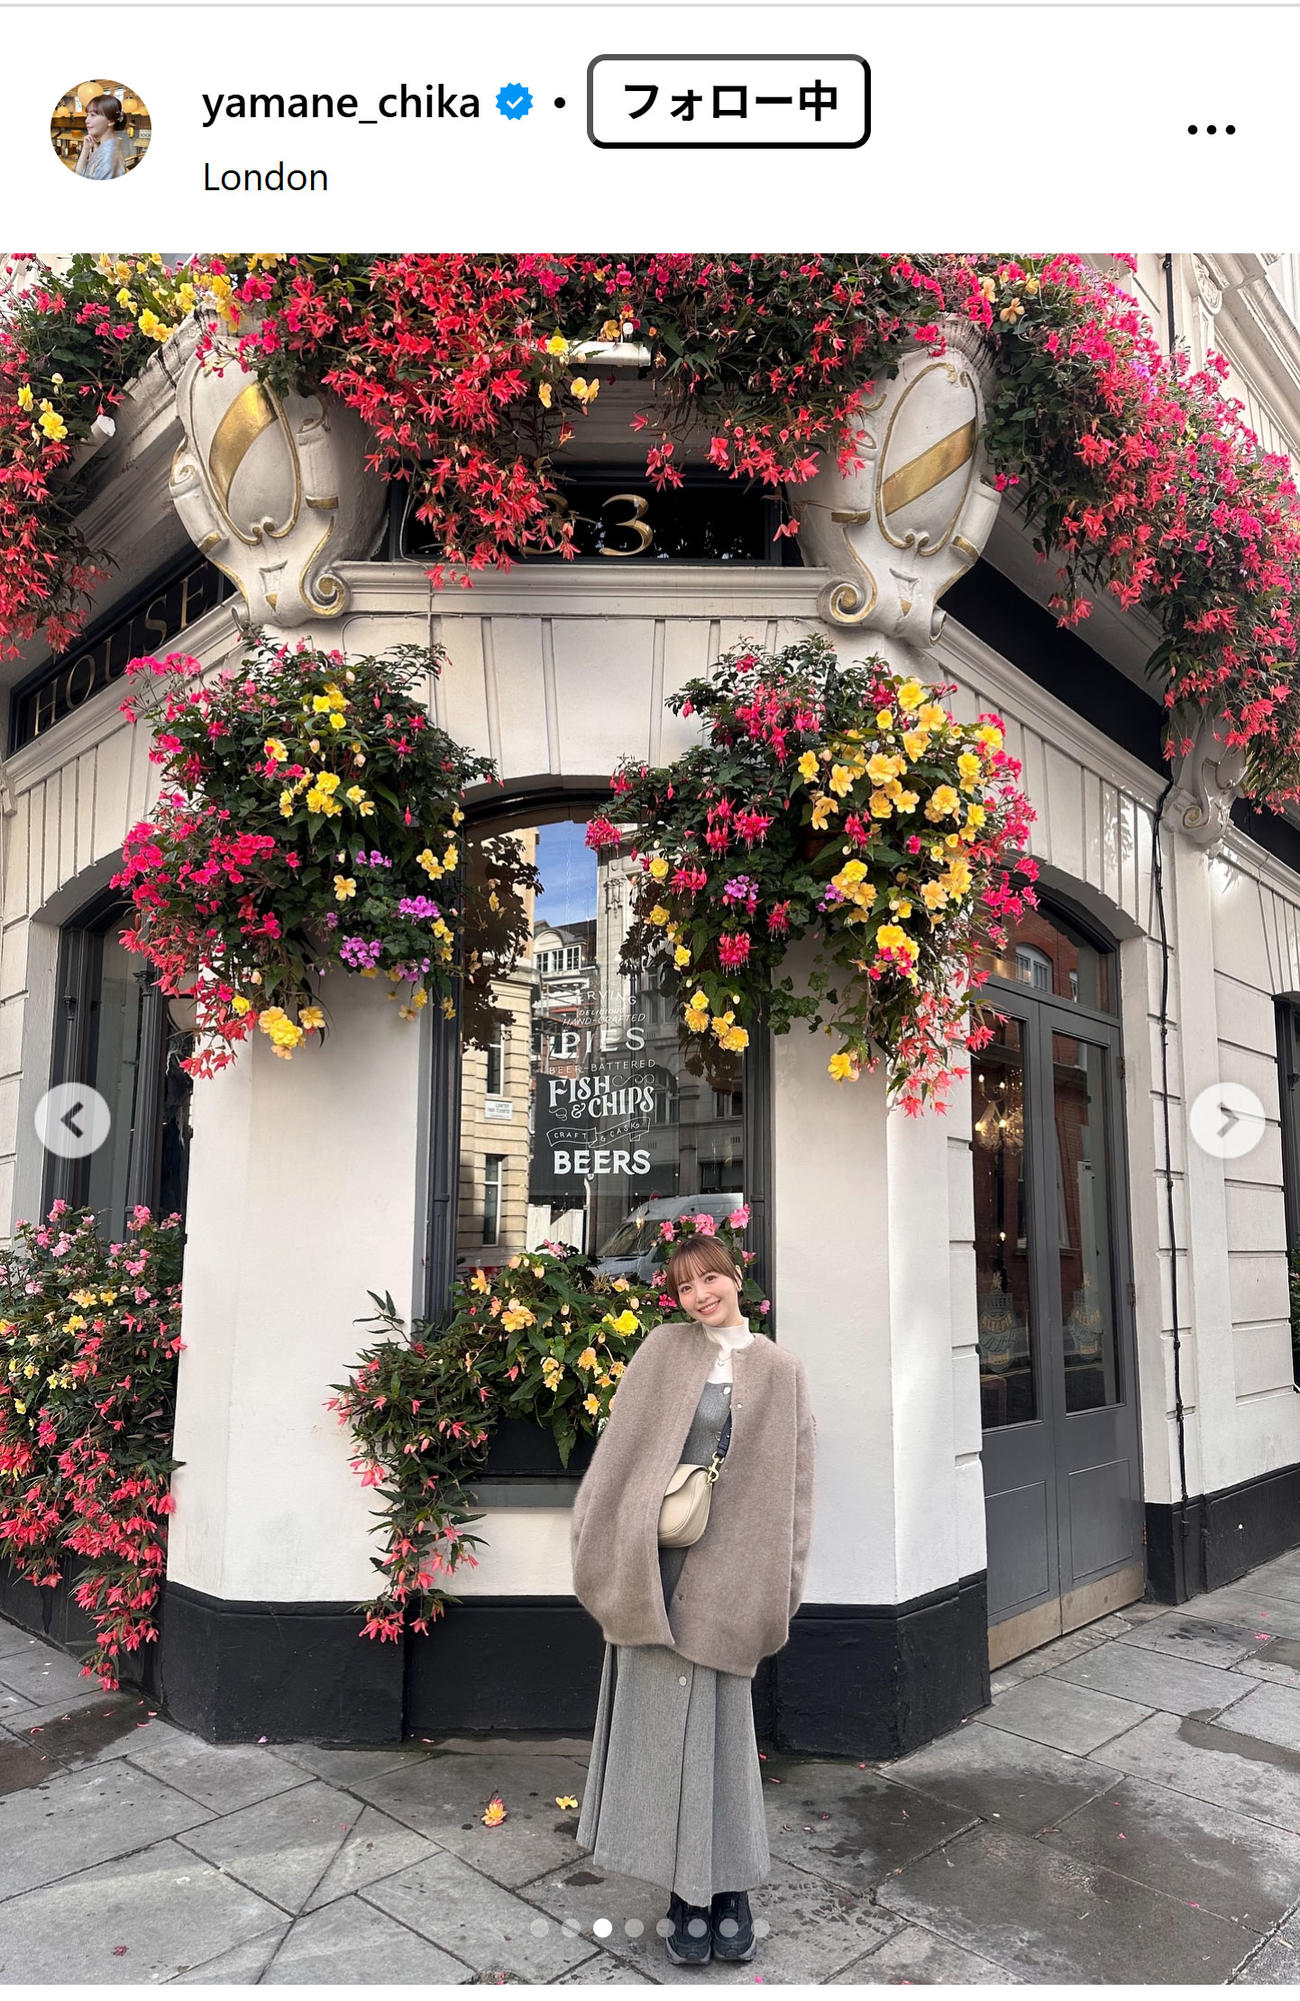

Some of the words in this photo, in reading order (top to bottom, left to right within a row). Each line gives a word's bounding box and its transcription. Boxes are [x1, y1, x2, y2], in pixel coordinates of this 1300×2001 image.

[33, 560, 208, 738] HOUSE
[562, 1013, 646, 1026] HAND-CRAFTED
[561, 1027, 645, 1054] PIES
[549, 1059, 656, 1075] BEER-BATTERED
[548, 1075, 611, 1107] FISH
[571, 1102, 586, 1119] &
[588, 1086, 654, 1118] CHIPS
[553, 1132, 588, 1140] CRAFT
[553, 1149, 651, 1176] BEERS
